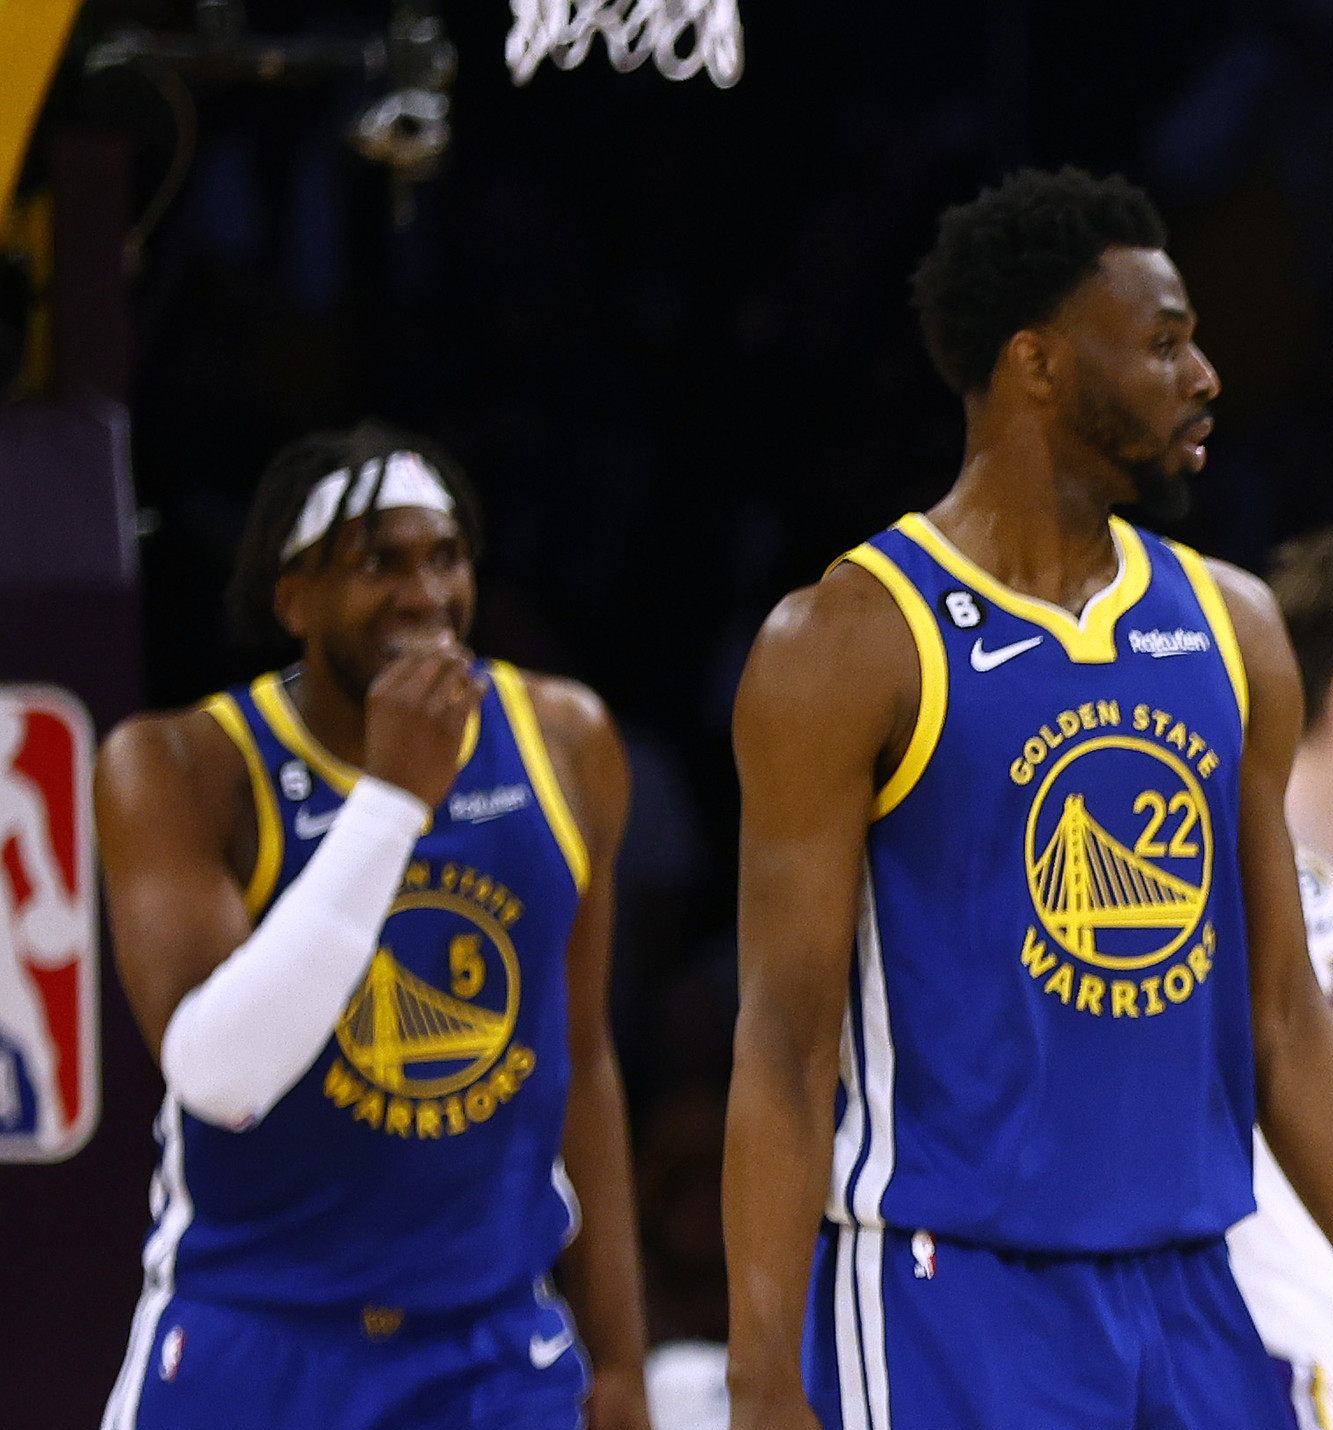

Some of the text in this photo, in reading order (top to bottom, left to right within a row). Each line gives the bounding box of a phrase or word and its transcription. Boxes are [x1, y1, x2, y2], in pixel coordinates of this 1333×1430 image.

[945, 590, 981, 628] 6
[1128, 628, 1210, 656] Rakuten
[1009, 699, 1220, 786] GOLDEN STATE
[1133, 789, 1200, 858] 22
[450, 933, 487, 999] 5
[323, 1042, 537, 1140] WARRIORS
